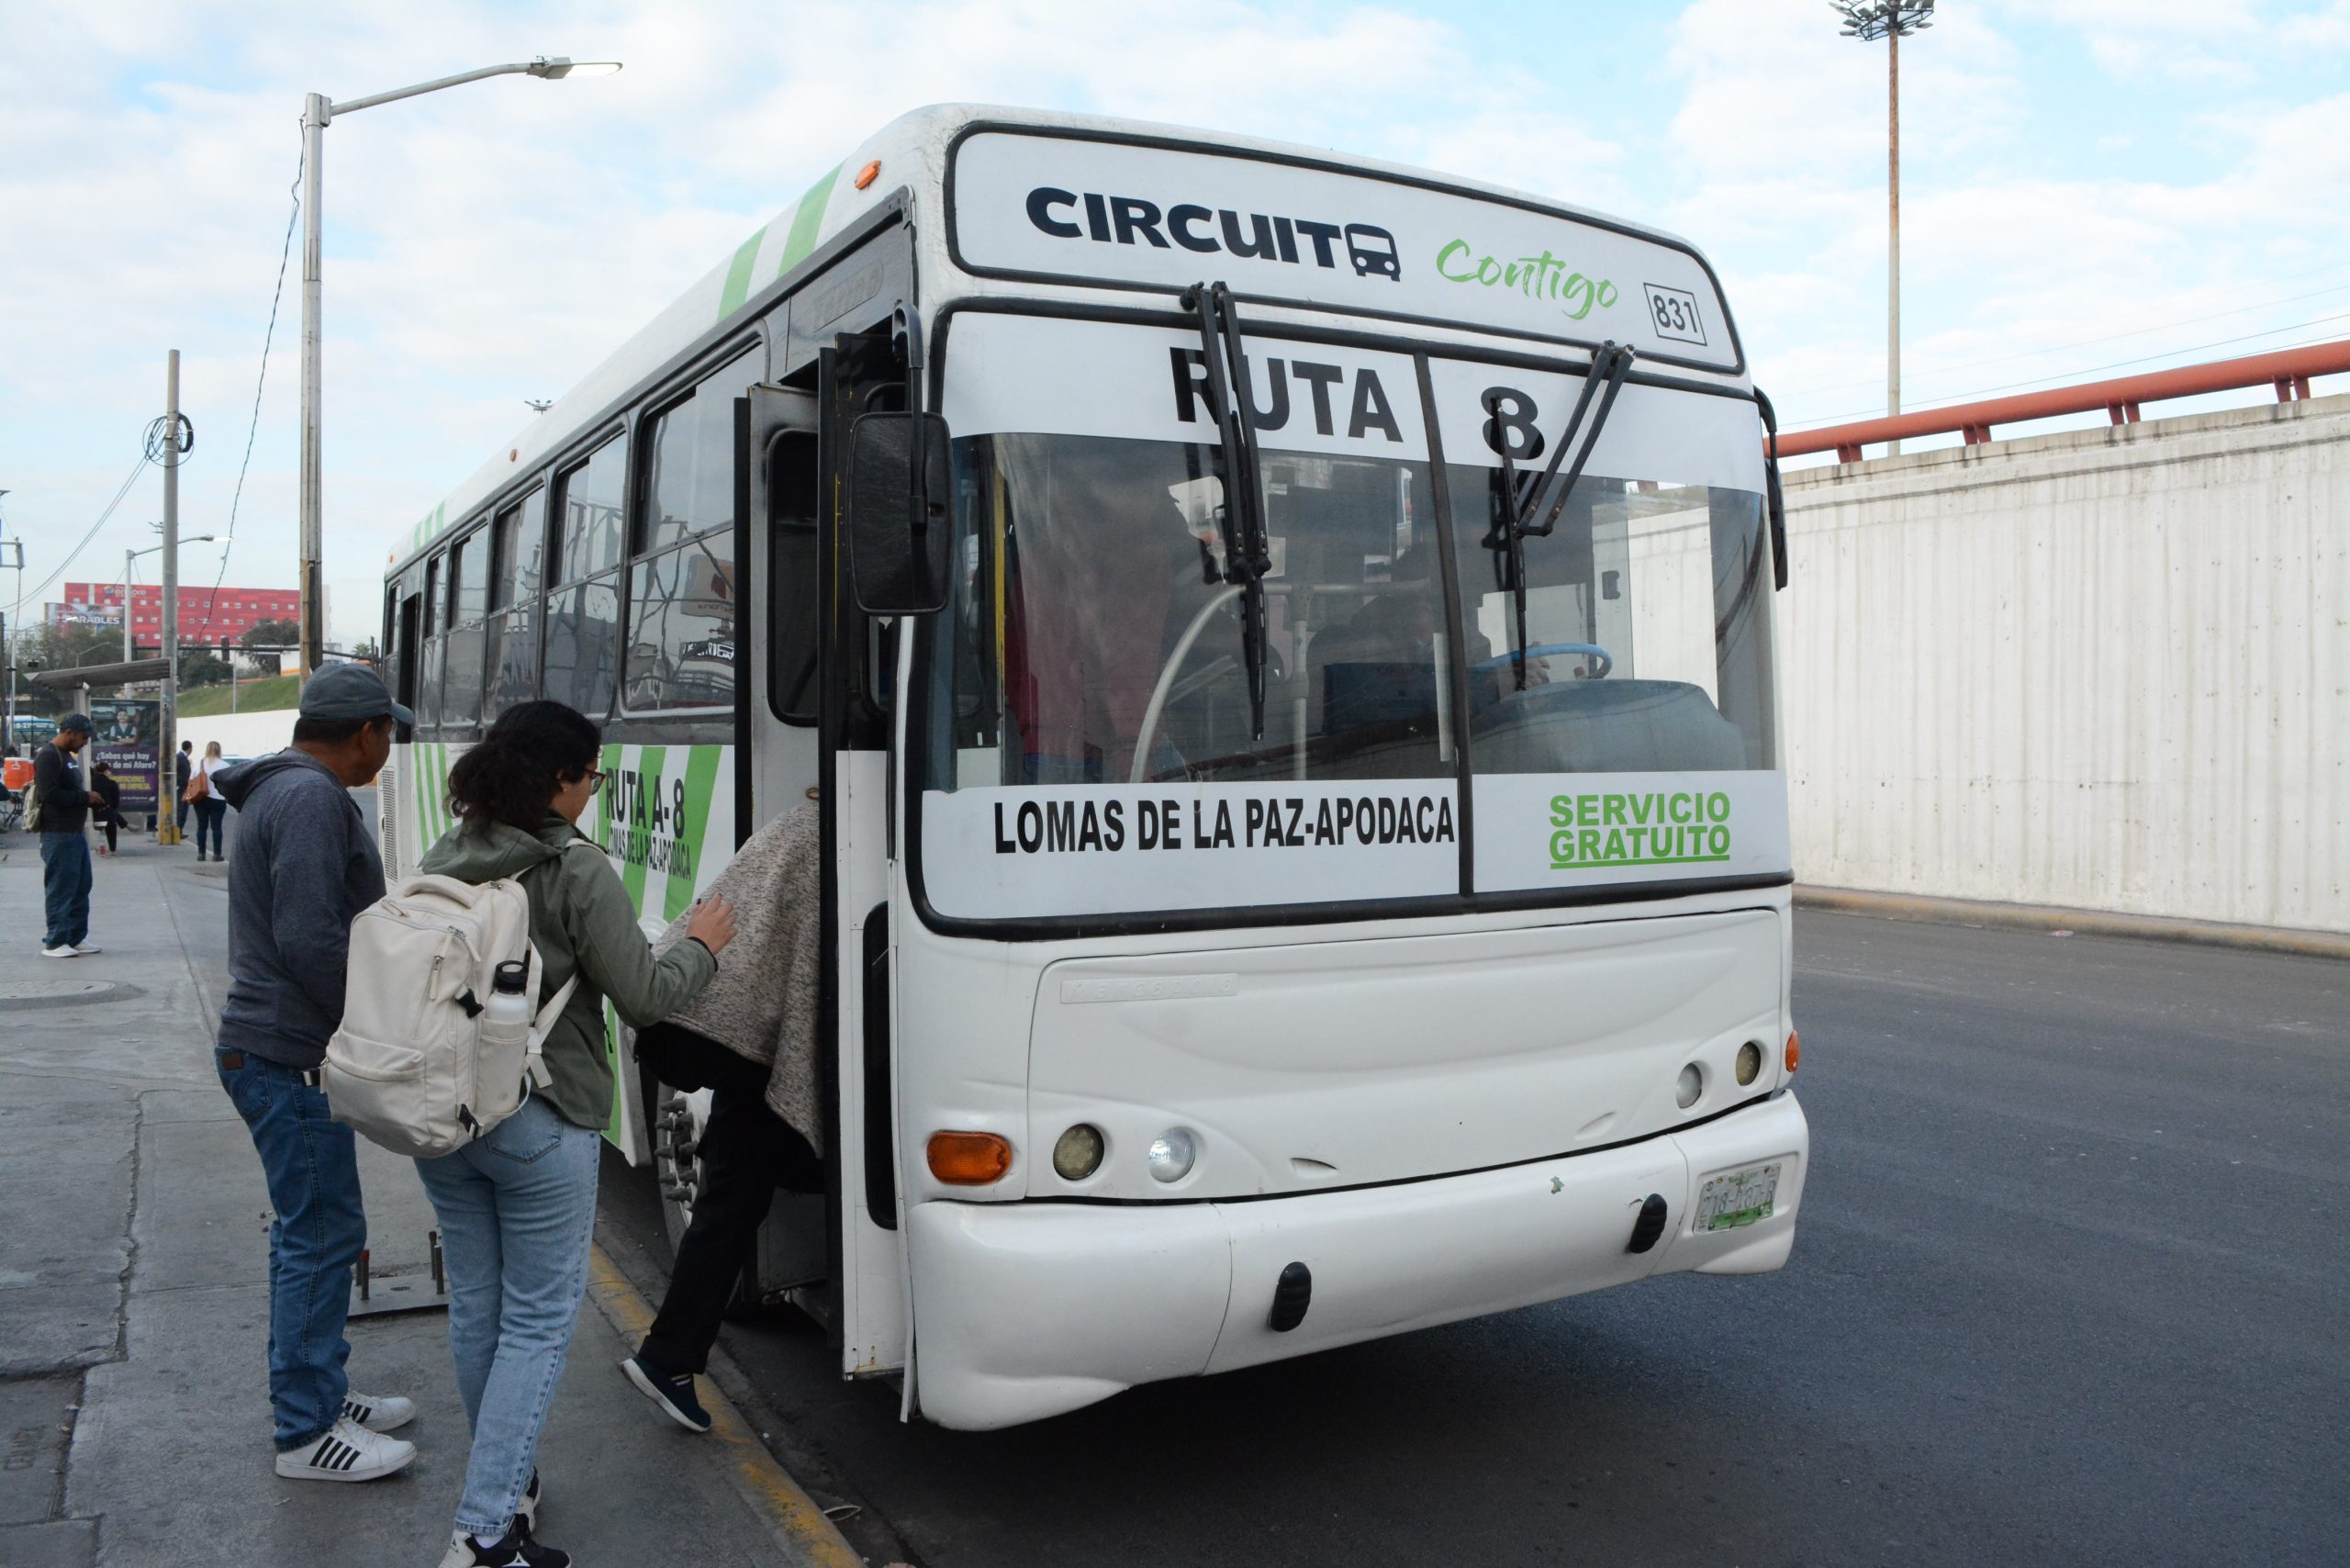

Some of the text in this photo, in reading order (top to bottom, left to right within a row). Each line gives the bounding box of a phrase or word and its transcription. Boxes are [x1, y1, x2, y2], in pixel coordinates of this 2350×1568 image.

[1436, 239, 1617, 319] Contigo
[1652, 295, 1698, 333] 831
[1169, 347, 1545, 460] RUTA 8
[137, 752, 150, 761] hay
[606, 767, 685, 839] RUTA A-8
[1549, 791, 1731, 828] SERVICIO
[607, 825, 626, 861] LOMAS
[627, 830, 635, 864] DE
[636, 832, 645, 868] LA
[994, 796, 1455, 855] LOMAS DE LA PAZ-APODACA
[1549, 824, 1731, 863] GRATUITO
